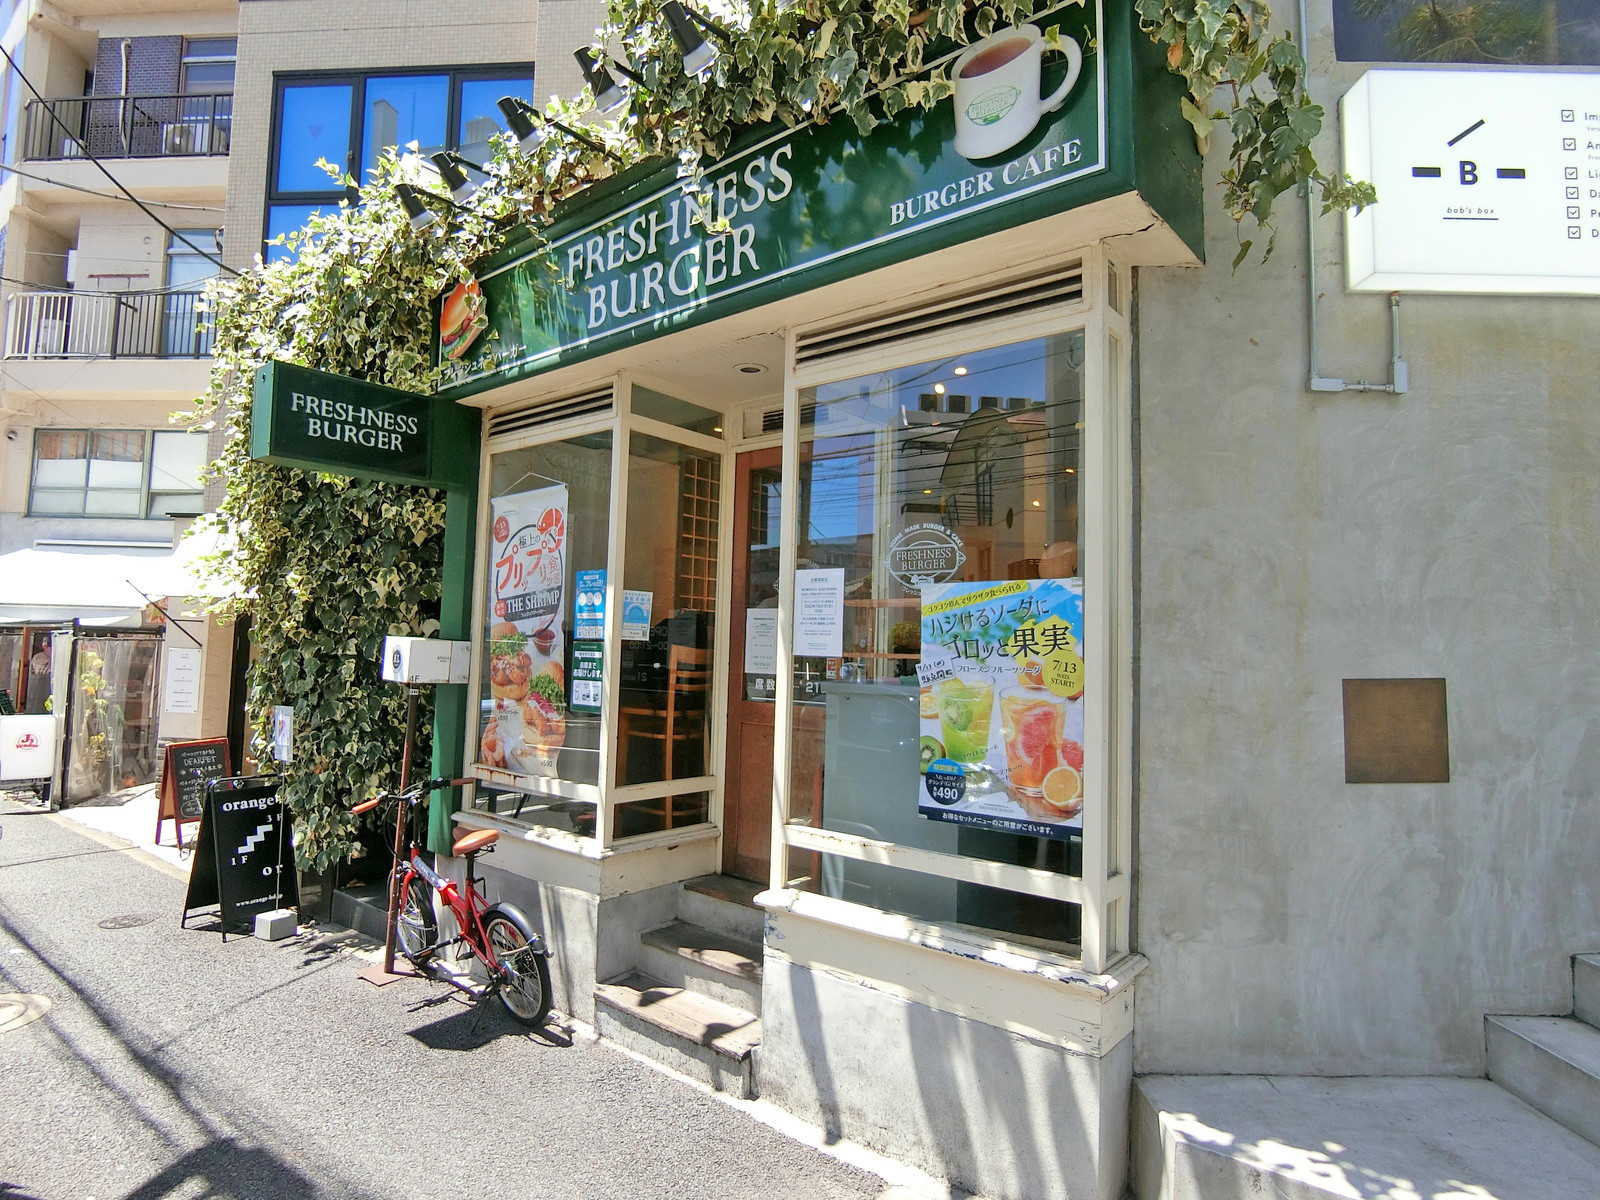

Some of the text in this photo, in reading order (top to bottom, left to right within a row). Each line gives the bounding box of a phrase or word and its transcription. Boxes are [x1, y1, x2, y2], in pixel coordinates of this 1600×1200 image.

[889, 138, 1083, 226] BURGER CAFE
[1459, 160, 1478, 185] B
[1588, 170, 1600, 179] Li
[566, 142, 794, 289] FRESHNESS
[1447, 207, 1495, 215] bob's box
[586, 223, 760, 330] BURGER
[290, 391, 418, 435] FRESHNESS
[307, 417, 404, 453] BURGER
[519, 532, 541, 549] 極上の
[888, 531, 903, 548] HOME
[904, 523, 920, 534] MADE
[923, 522, 945, 532] BURGER
[951, 533, 964, 548] CAKE
[896, 547, 952, 561] FRESHNESS
[902, 559, 946, 571] BURGER
[506, 598, 524, 614] THE
[525, 590, 560, 610] SHRIMP
[927, 584, 1023, 614] ゴクゴク飲んでザクザク食べられる
[930, 595, 1051, 638] ハジけるソーダに
[942, 624, 1072, 661] ゴロッと果実
[408, 674, 421, 683] 4F
[956, 664, 1041, 676] フローズンフルーツソーダ
[1053, 659, 1077, 674] 7/13
[754, 678, 776, 691] 席数
[1050, 677, 1075, 688] START!
[942, 811, 1055, 835] お得なセットメニューのご用意がございます。
